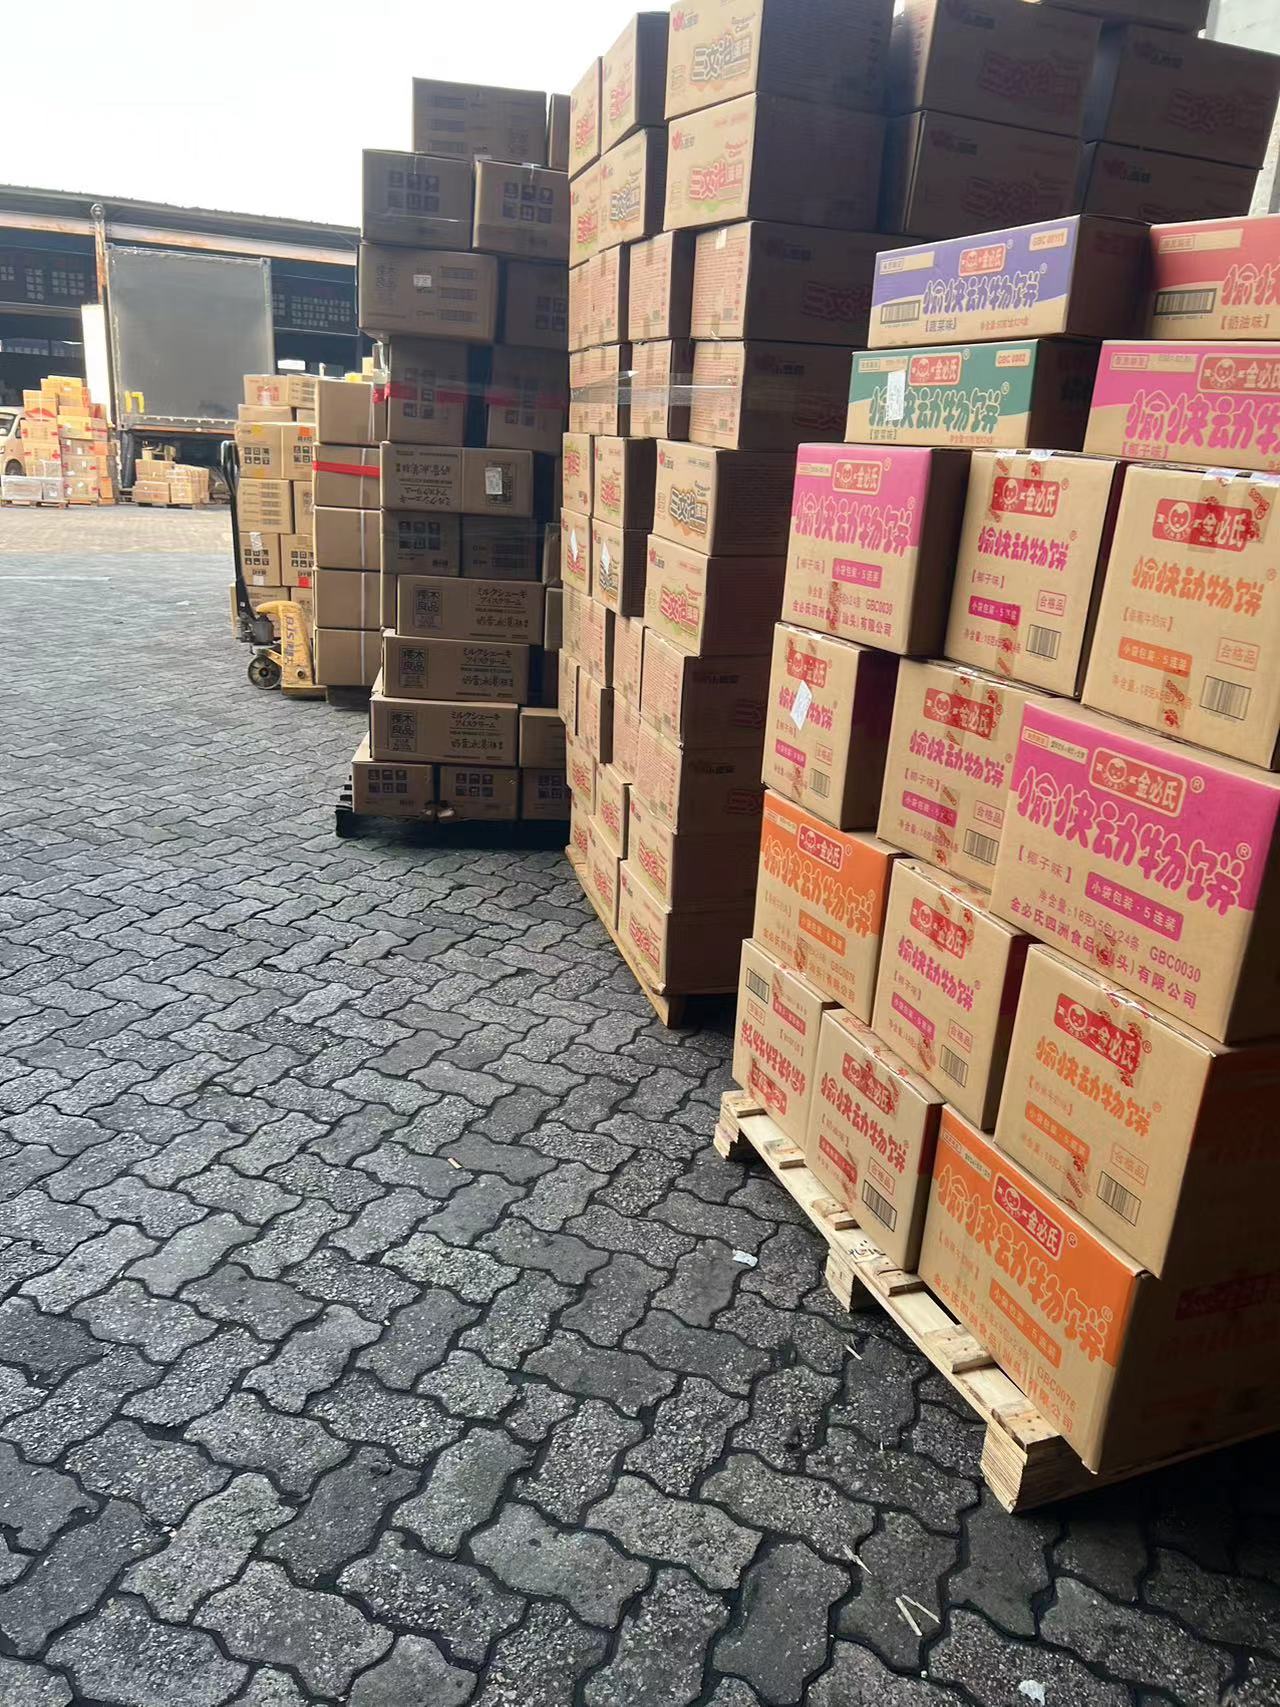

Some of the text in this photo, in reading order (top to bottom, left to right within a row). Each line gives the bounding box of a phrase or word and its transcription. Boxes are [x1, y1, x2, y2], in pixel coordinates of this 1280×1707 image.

[923, 271, 1040, 314] 愉快动物饼
[855, 466, 879, 489] 金必氏
[1024, 484, 1056, 513] 金必氏
[795, 491, 911, 557] 愉快动物饼
[1202, 511, 1246, 547] 金必氏
[978, 525, 1069, 572] 愉快动物饼
[1132, 555, 1265, 617] 愉快动物饼
[779, 685, 834, 732] 愉物饼
[959, 703, 991, 738] 金必氏
[909, 730, 1004, 788] 愉快动物饼
[1135, 769, 1178, 810] 金必氏
[820, 840, 840, 867] 金必氏
[1017, 766, 1245, 916] 愉快动物饼
[1018, 845, 1073, 885] 【椰子味】
[764, 835, 872, 938] 愉快动物饼
[898, 935, 974, 1012] 愉快动物饼
[1150, 945, 1201, 983] GBC0030
[1096, 1025, 1137, 1074] 金必氏
[1035, 1036, 1152, 1136] 愉快动物饼
[821, 1071, 908, 1174] 愉快动物饼
[1026, 1207, 1059, 1256] 金必氏
[936, 1164, 1109, 1363] 愉快动物饼
